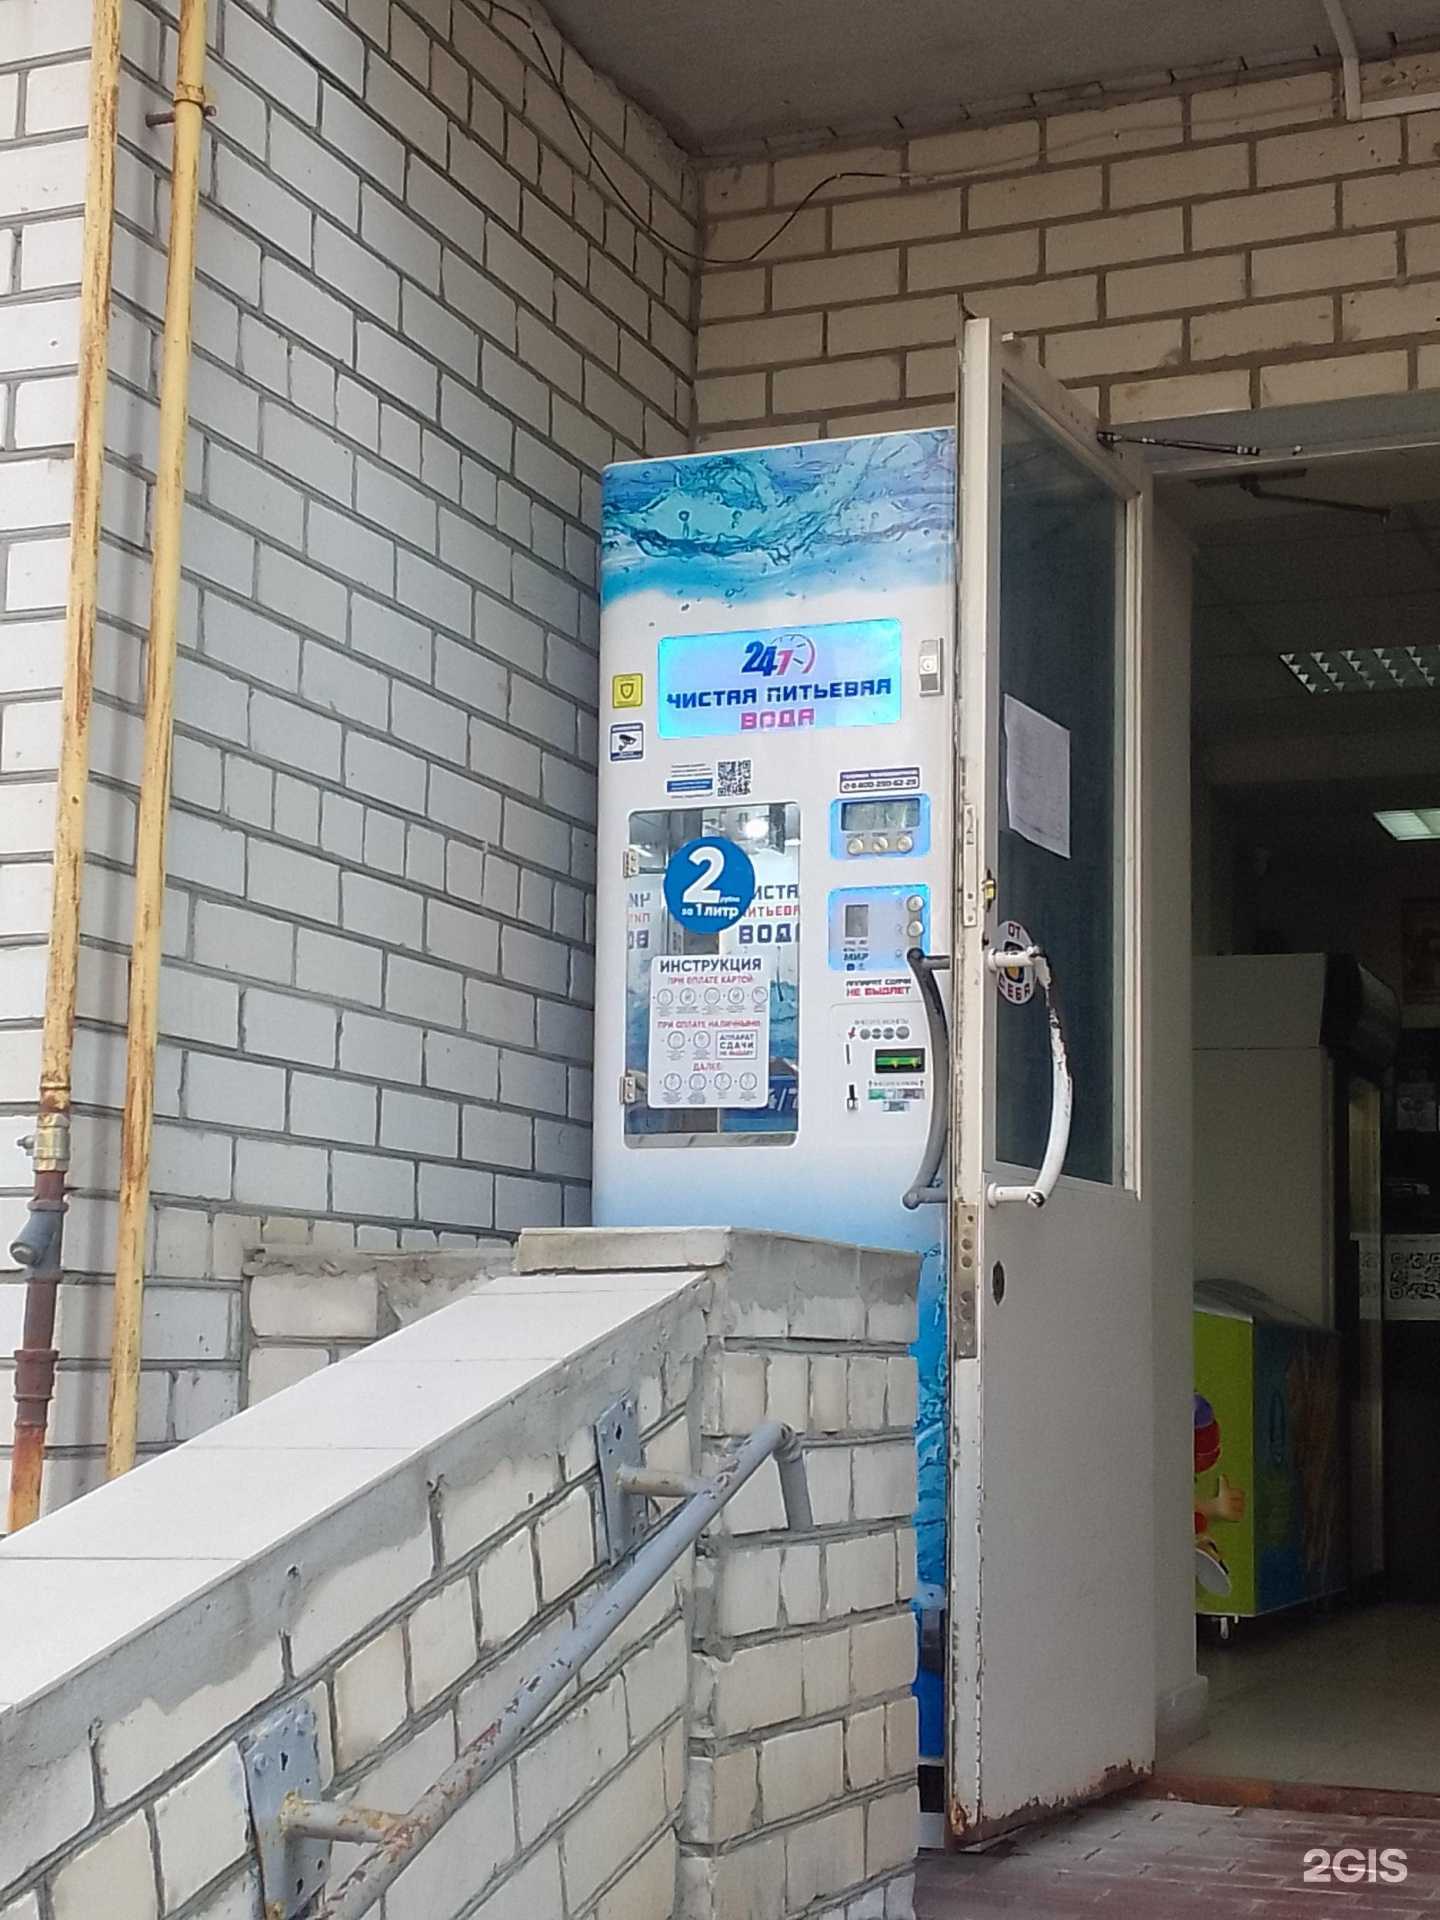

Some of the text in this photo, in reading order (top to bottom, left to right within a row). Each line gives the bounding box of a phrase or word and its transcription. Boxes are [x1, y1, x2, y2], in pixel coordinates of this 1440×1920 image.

[667, 678, 892, 709] ЧИСТАЯ ПИТЬЕВАЯ
[741, 708, 815, 730] ВОДА
[682, 846, 725, 904] 2
[755, 884, 799, 900] ИСТА
[682, 903, 740, 920] за 1 литр
[660, 958, 762, 973] ИНСТРУКЦИЯ
[669, 974, 754, 984] ПРИ ОПЛАТЕ КАРТОЙ
[846, 988, 861, 997] НЕ
[675, 1020, 706, 1028] ОПЛАТЕ
[720, 1041, 754, 1049] СДАЧИ
